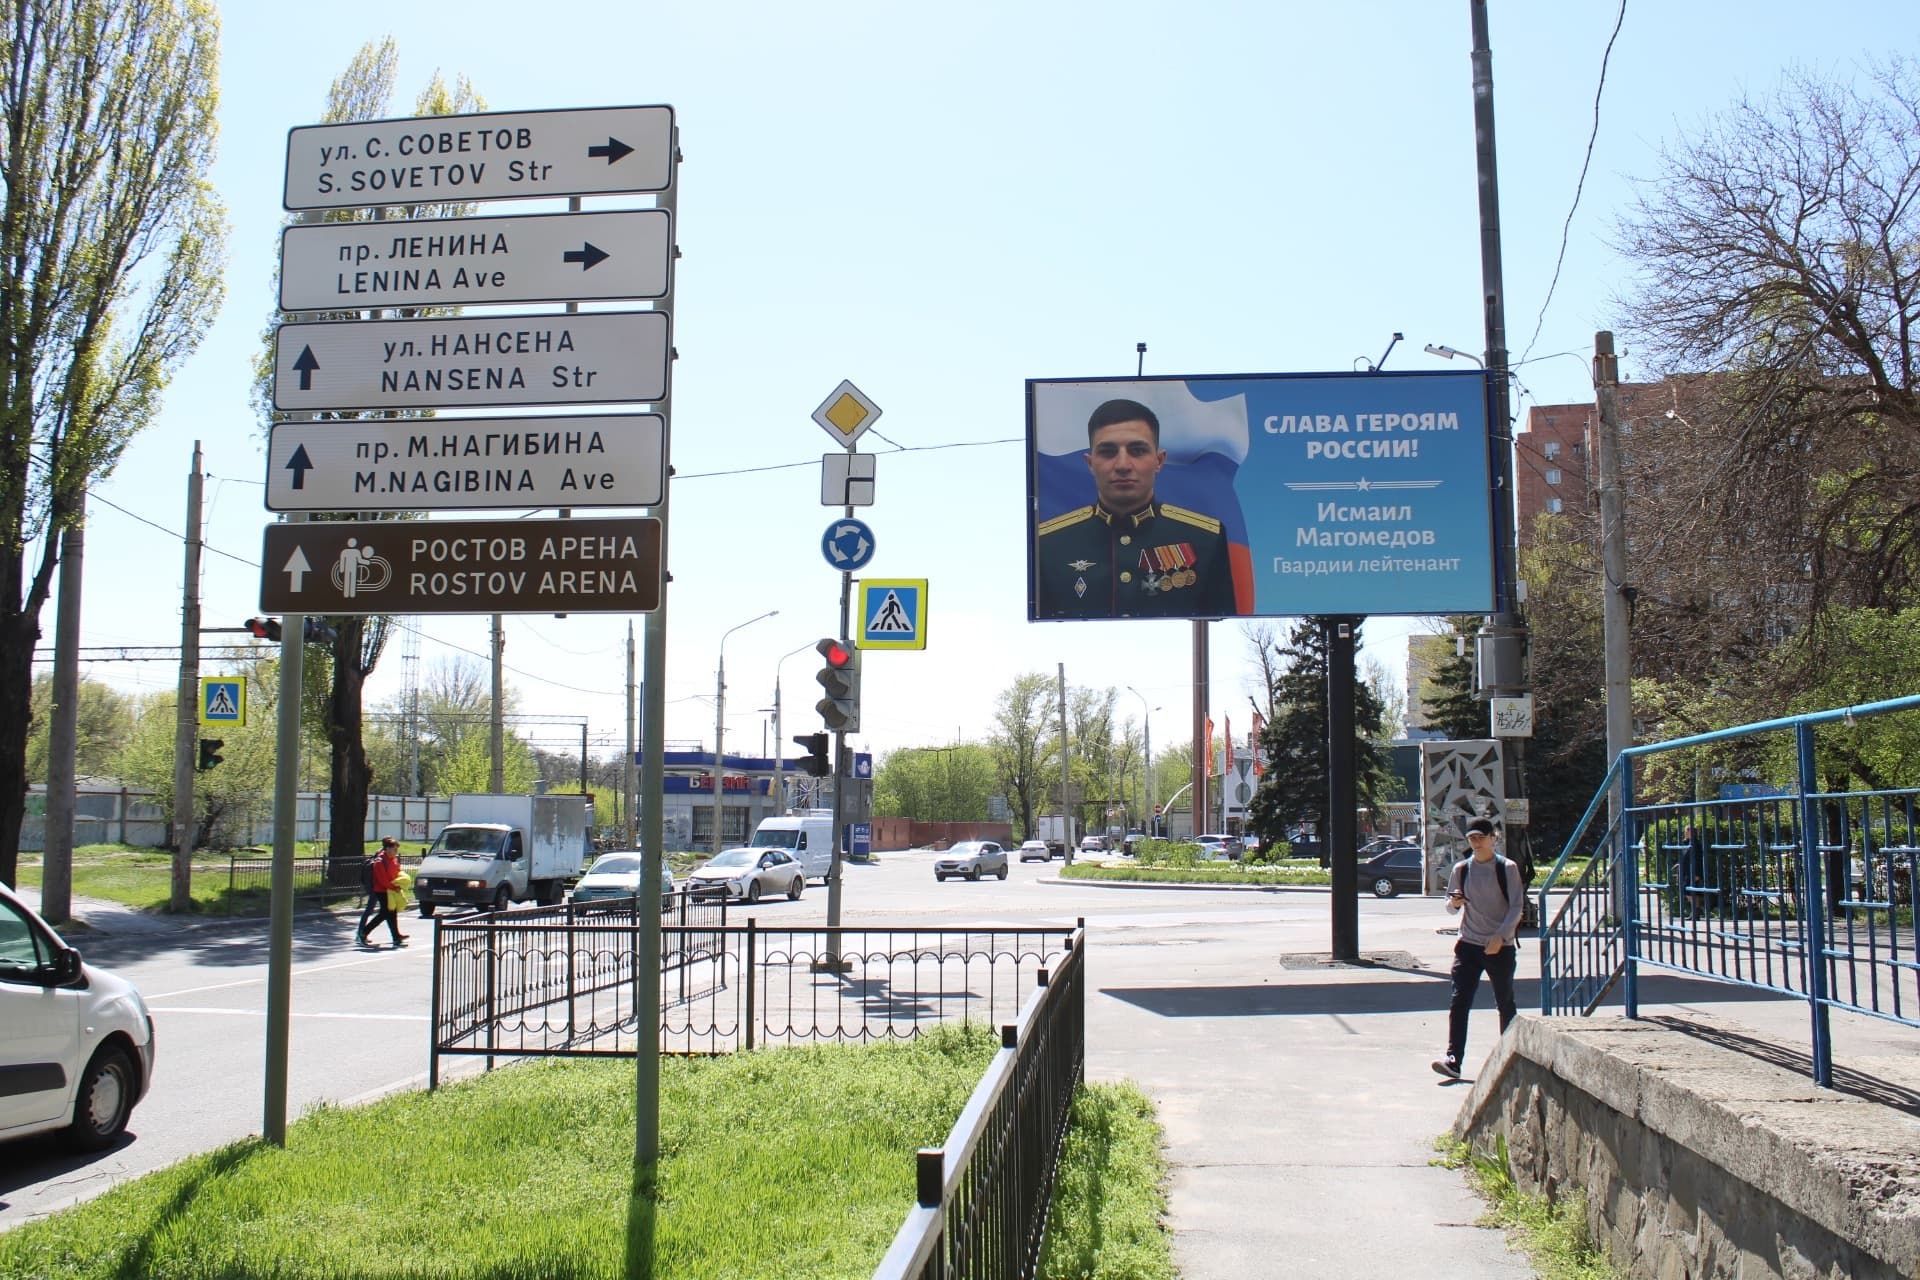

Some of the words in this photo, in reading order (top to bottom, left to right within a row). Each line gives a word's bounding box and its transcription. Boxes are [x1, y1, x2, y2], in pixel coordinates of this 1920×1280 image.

[320, 145, 357, 167] ул.
[508, 160, 553, 182] Str
[339, 244, 380, 267] пр.
[388, 233, 509, 259] ЛЕНИНА
[337, 268, 442, 294] LENINA
[452, 267, 506, 289] Ave
[383, 341, 422, 364] ул.
[431, 330, 575, 357] НАНСЕНА
[381, 367, 526, 393] NANSENA
[552, 365, 597, 388] Str
[1263, 414, 1350, 434] СЛАВА
[1355, 412, 1459, 433] ГЕРОЯМ
[356, 442, 399, 465] пр.
[1306, 438, 1418, 460] РОССИИ!
[560, 468, 615, 491] Ave
[1317, 502, 1412, 522] Исмаил
[411, 538, 526, 562] РОСТОВ
[539, 536, 638, 560] АРЕНА
[1295, 527, 1436, 549] Магомедов
[1273, 556, 1353, 577] Гвардии
[1357, 555, 1461, 573] лейтенант
[410, 571, 527, 596] ROSTOV
[538, 570, 638, 594] ARENA
